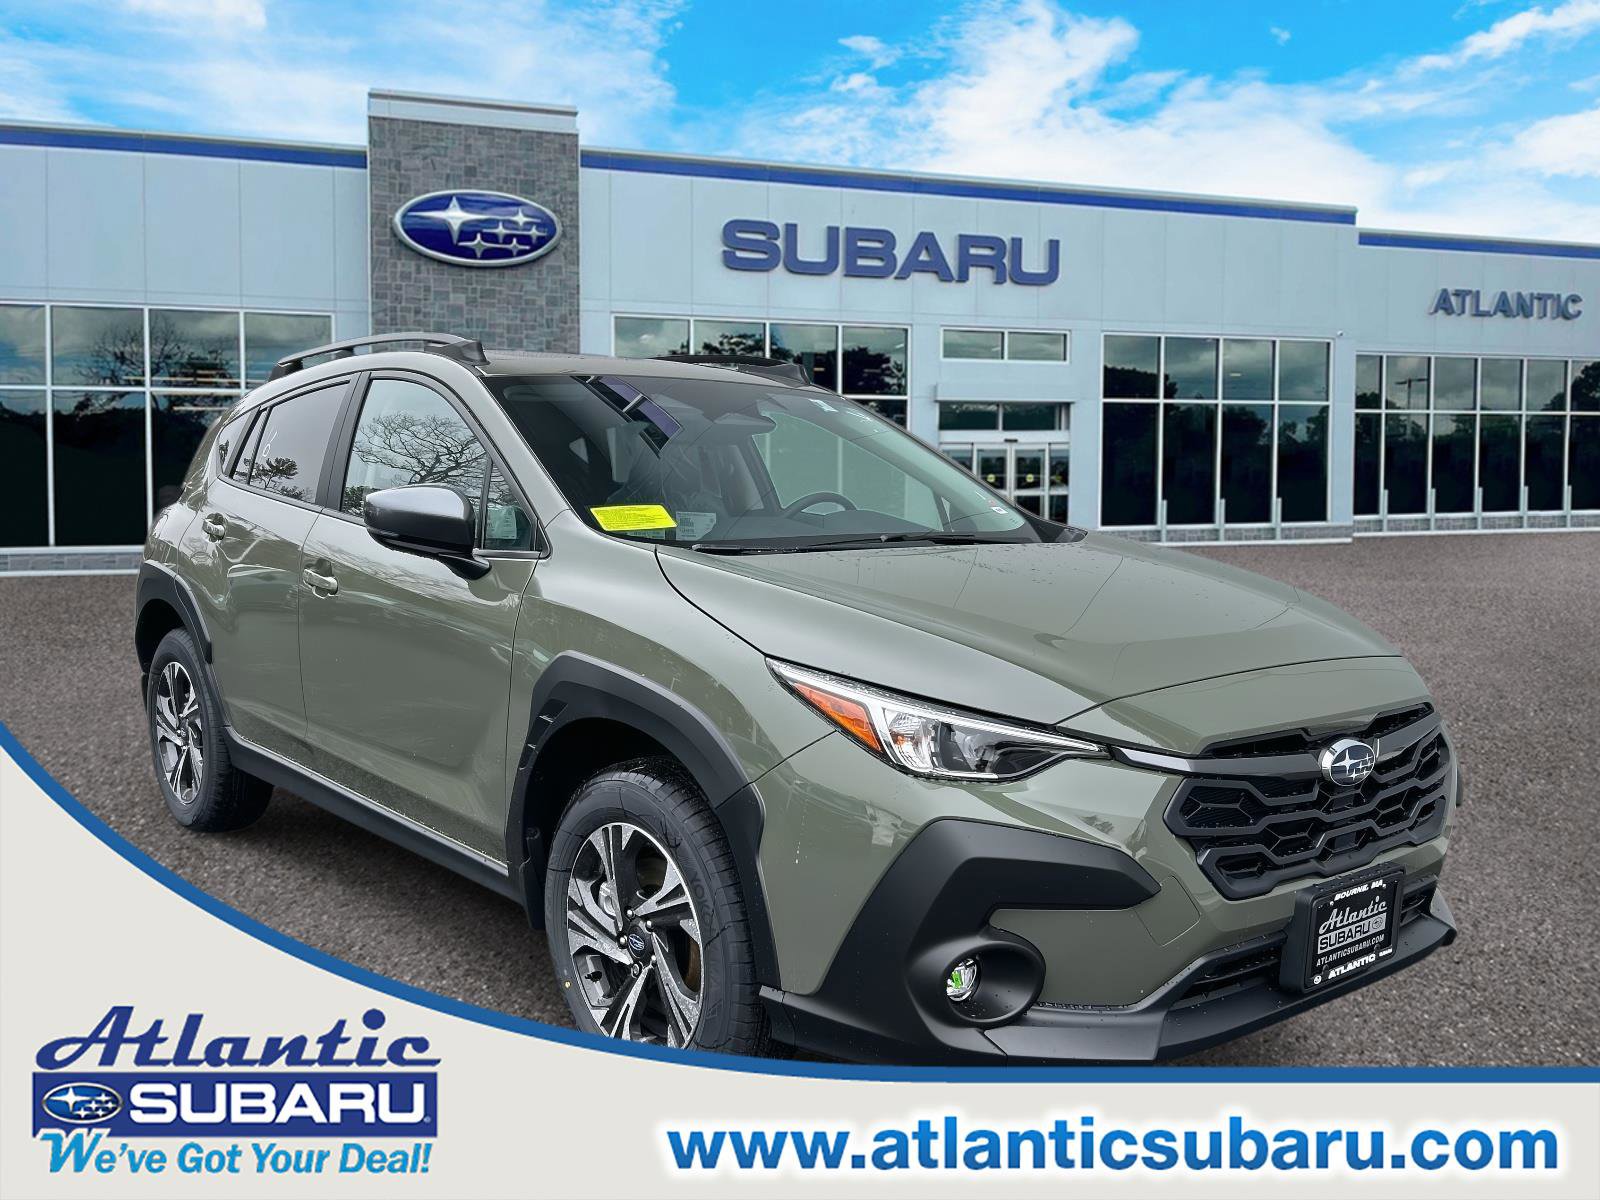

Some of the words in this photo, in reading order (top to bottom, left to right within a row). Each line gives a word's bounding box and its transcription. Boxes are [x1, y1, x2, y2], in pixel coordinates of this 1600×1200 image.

[722, 218, 1061, 286] SUBARU
[1430, 288, 1583, 321] ATLANTIC
[1319, 895, 1387, 934] Atlantic
[1319, 920, 1371, 951] SUBARU
[1328, 953, 1376, 979] ATLANTIC
